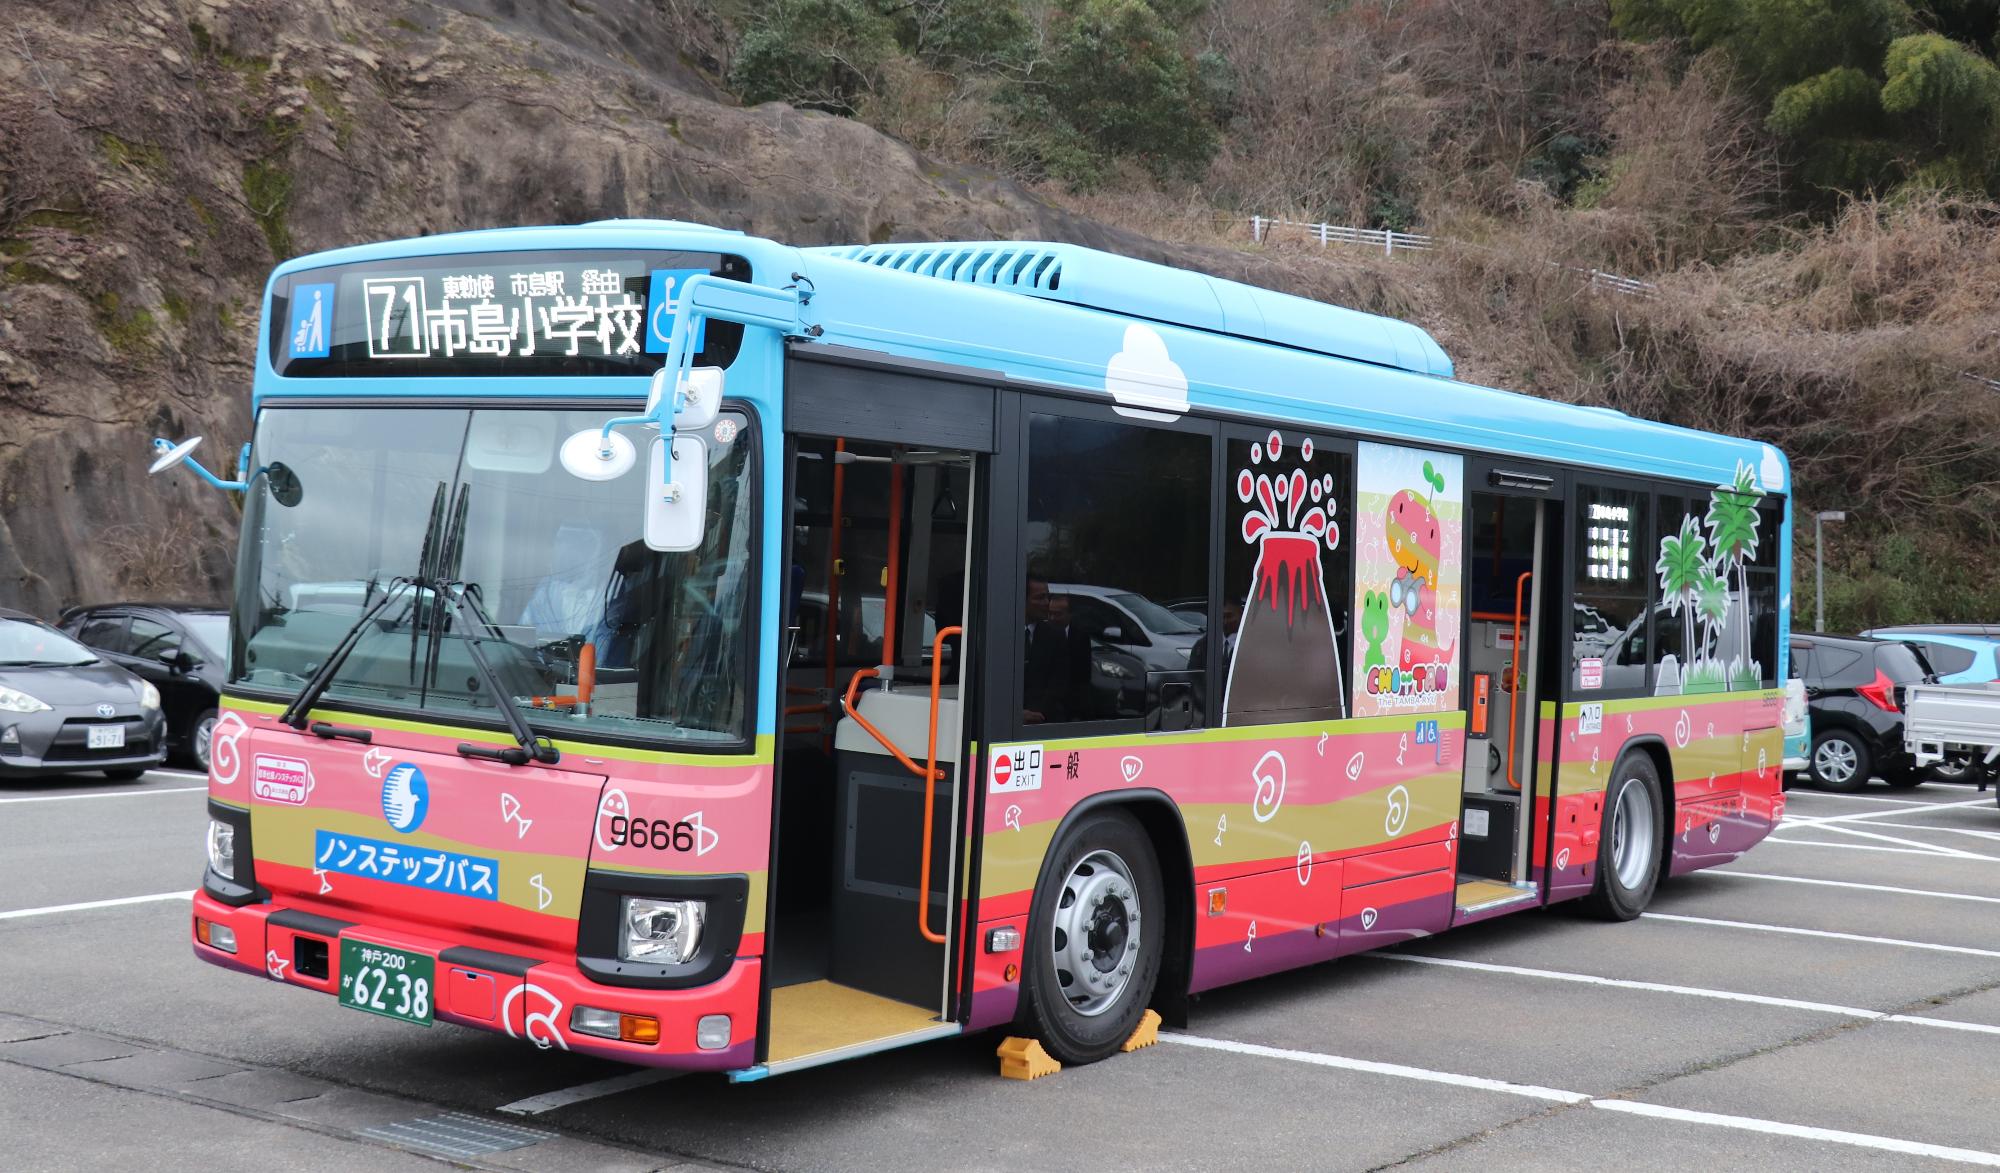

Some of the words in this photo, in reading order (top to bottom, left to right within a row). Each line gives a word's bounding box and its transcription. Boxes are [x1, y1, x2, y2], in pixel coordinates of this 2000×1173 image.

[509, 270, 565, 297] 市島駅
[581, 268, 621, 295] 経由
[369, 284, 421, 350] 71
[426, 294, 643, 357] 市島小学校
[1013, 749, 1041, 771] 出口
[1049, 751, 1080, 780] 一般
[1015, 774, 1036, 787] EXIT
[610, 815, 694, 852] 9666
[319, 838, 493, 895] ノンステップバス
[354, 965, 429, 1019] 62-38
